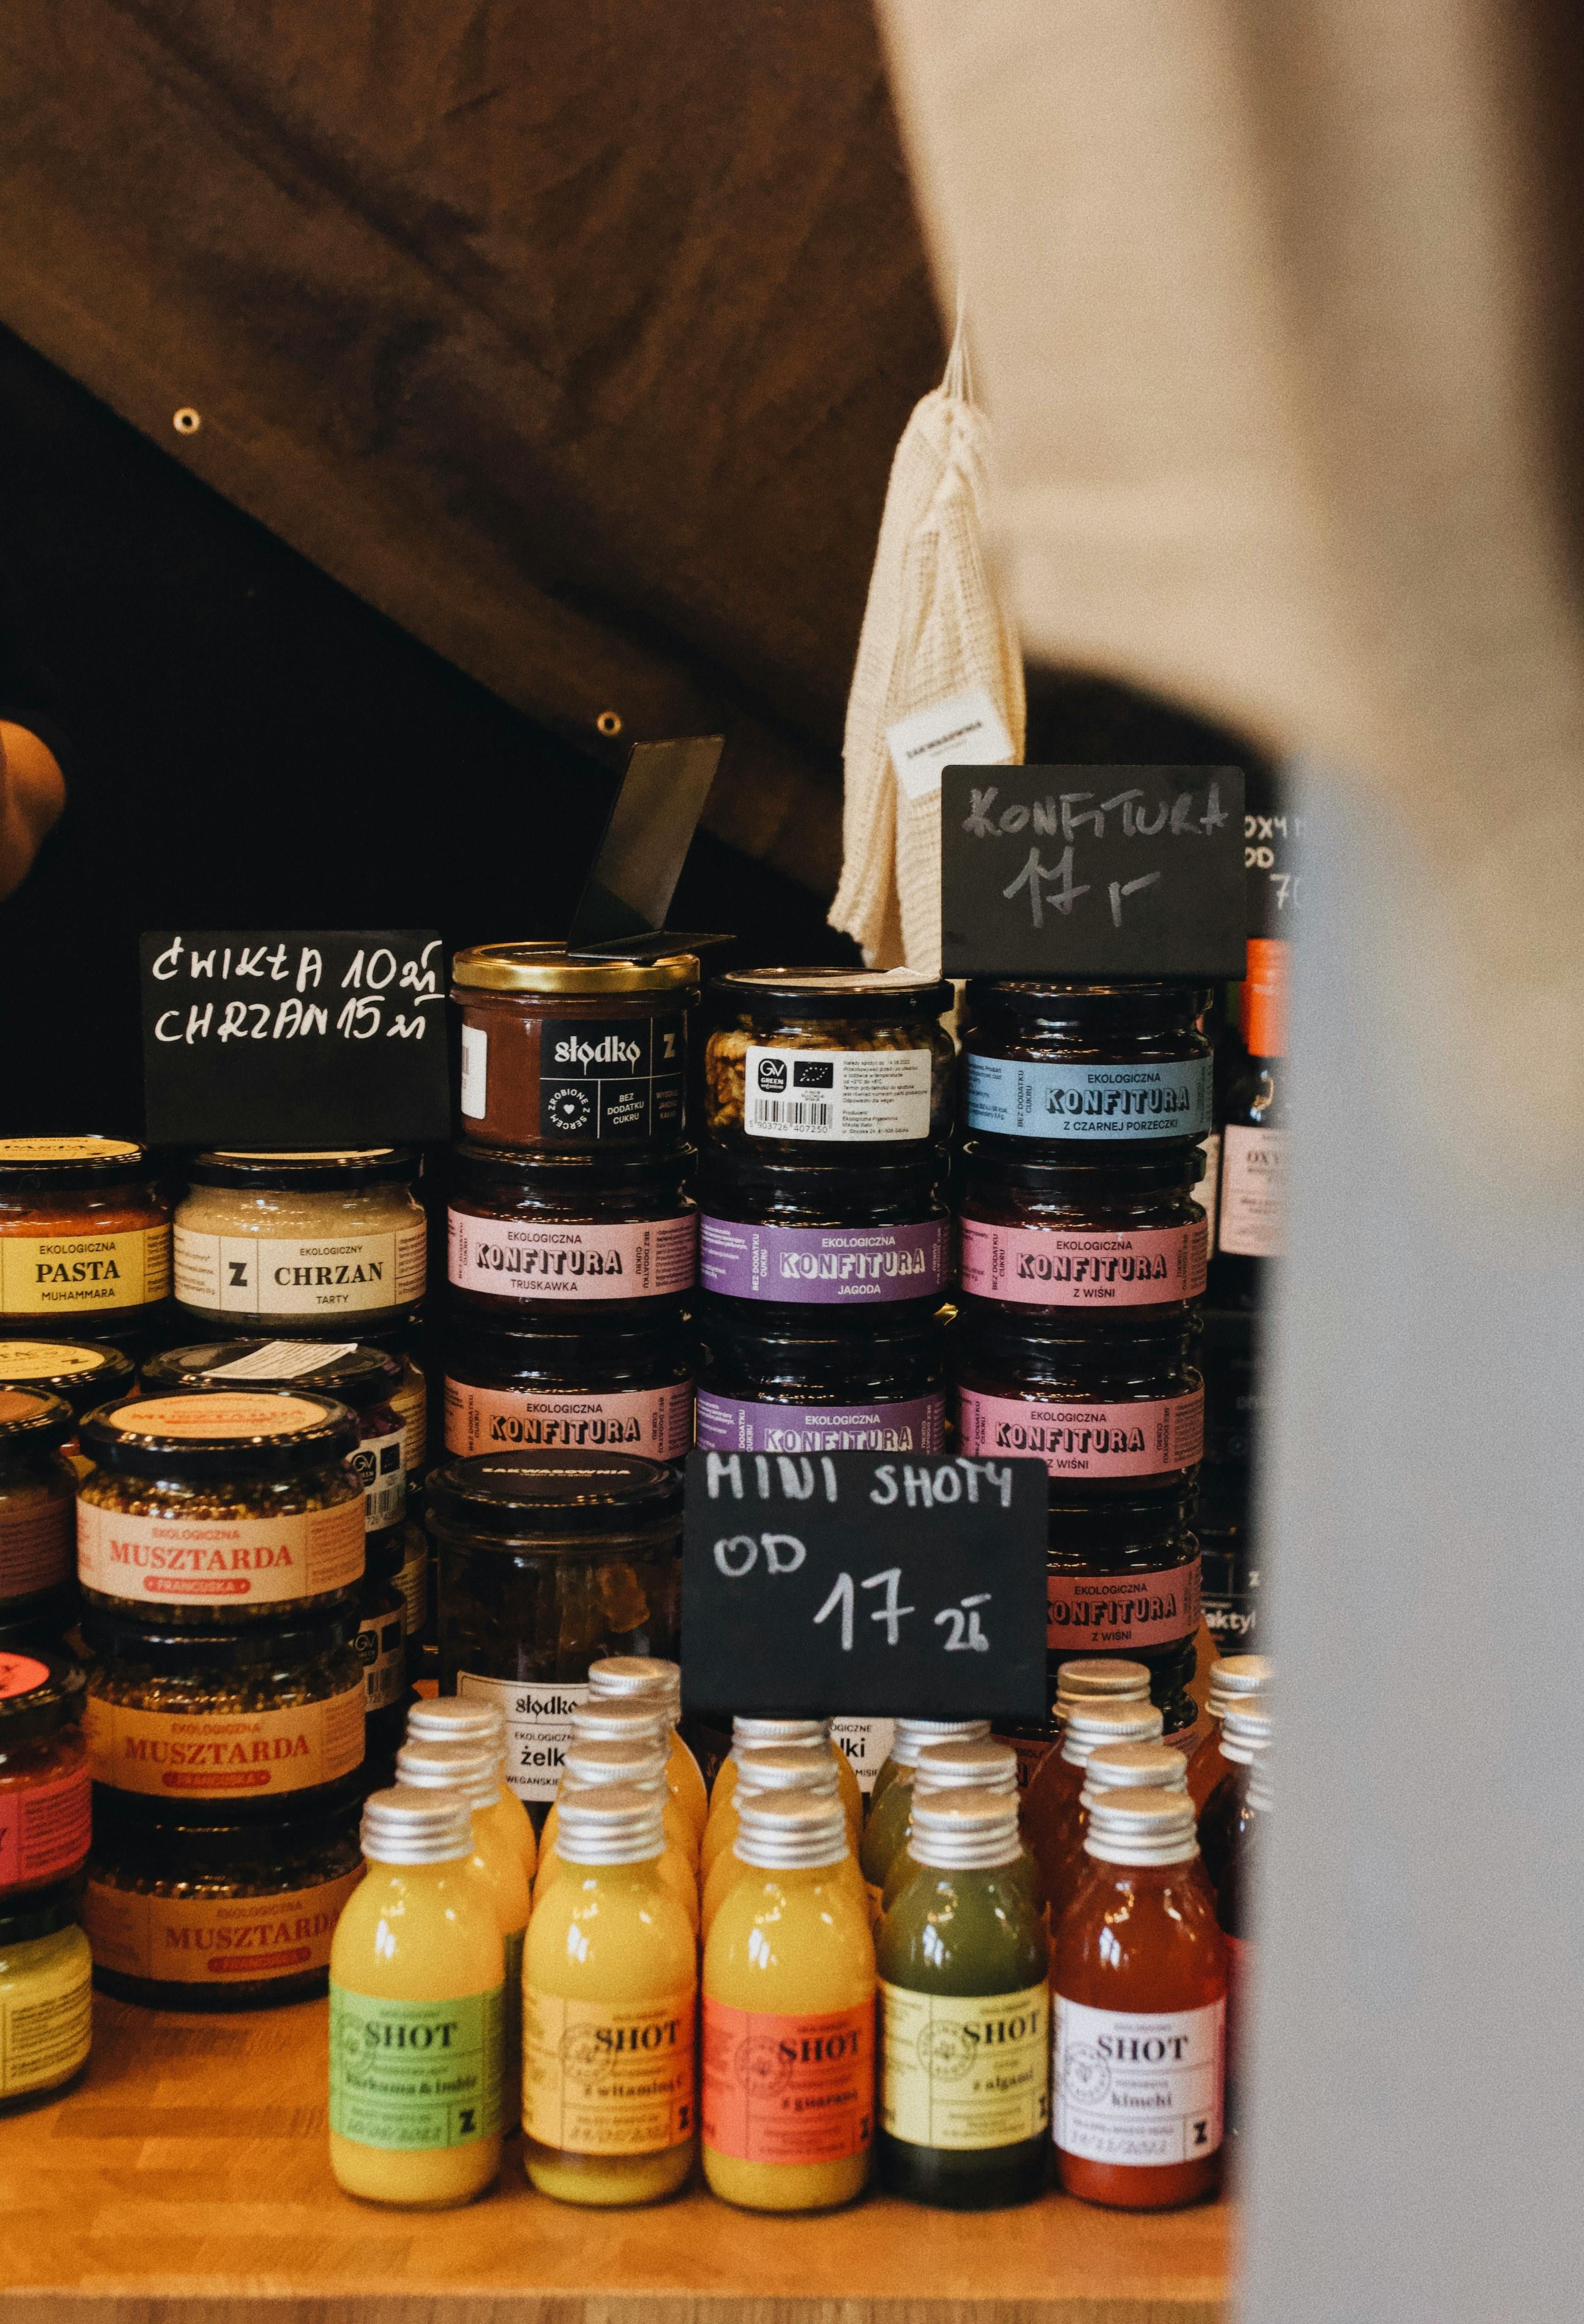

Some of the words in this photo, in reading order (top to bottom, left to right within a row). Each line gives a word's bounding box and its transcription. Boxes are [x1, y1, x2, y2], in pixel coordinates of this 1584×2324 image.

[155, 998, 327, 1044] CHRZAN
[554, 1036, 641, 1076] słodko
[663, 1033, 676, 1058] Z
[1087, 1072, 1161, 1084] EKOLOGICZNA
[548, 1088, 589, 1111] ZROBIONE
[607, 1101, 645, 1115] DODATKU
[619, 1092, 634, 1103] BEZ
[1045, 1086, 1190, 1115] KONFITURA
[550, 1113, 587, 1130] SERCEM
[613, 1112, 639, 1124] CUKRU
[793, 1125, 828, 1133] 407250
[1063, 1121, 1071, 1131] Z
[1073, 1121, 1124, 1132] CZARNEJ
[1126, 1118, 1178, 1131] PORZECZKI
[39, 1240, 117, 1255] EKOLOGICZNA
[300, 1245, 364, 1256] EKOLOGICZNY
[507, 1231, 583, 1245] EKOLOGICZNA
[821, 1235, 896, 1248] EKOLOGICZNA
[1056, 1240, 1133, 1251] EKOLOGICZNA
[474, 1241, 623, 1276] KONFITURA
[752, 1233, 760, 1274] DODATKU
[760, 1248, 768, 1278] CUKRU
[779, 1247, 926, 1280] KONFITURA
[35, 1259, 121, 1284] PASTA
[228, 1261, 248, 1287] Z
[274, 1261, 385, 1287] CHRZAN
[1016, 1253, 1168, 1282] KONFITURA
[41, 1287, 116, 1301] MUHAMMARA
[510, 1278, 578, 1292] TRUSKAWKA
[837, 1284, 881, 1296] JAGODA
[1073, 1288, 1080, 1299] Z
[1083, 1286, 1116, 1299] WIŚNI
[316, 1294, 349, 1306] TARTY
[526, 1403, 603, 1415] EKOLOGICZNA
[805, 1414, 880, 1425] EKOLOGICZNA
[1030, 1410, 1107, 1423] EKOLOGICZNA
[489, 1414, 641, 1445] KONFITURA
[764, 1425, 914, 1452] KONFITURA
[995, 1422, 1145, 1453] KONFITURA
[1047, 1459, 1053, 1469] Z
[1056, 1458, 1089, 1469] WIŚNI
[706, 1452, 838, 1503] MINI
[869, 1457, 1012, 1508] SHOTY
[109, 1539, 293, 1572] MUSZTARDA
[713, 1533, 808, 1577] OD
[1074, 1583, 1148, 1595] EKOLOGICZNA
[813, 1567, 916, 1652] 17
[1047, 1593, 1177, 1626] ONFITURA
[1092, 1632, 1098, 1642] Z
[1101, 1630, 1132, 1641] WIŚNI
[125, 1734, 310, 1765] MUSZTARDA
[365, 2020, 459, 2049] SHOT
[594, 2018, 681, 2052] SHOT
[963, 2009, 1040, 2049] SHOT
[779, 2029, 859, 2063] SHOT
[1097, 2033, 1189, 2061] SHOT
[458, 2109, 477, 2135] Z
[1193, 2120, 1208, 2145] Z
